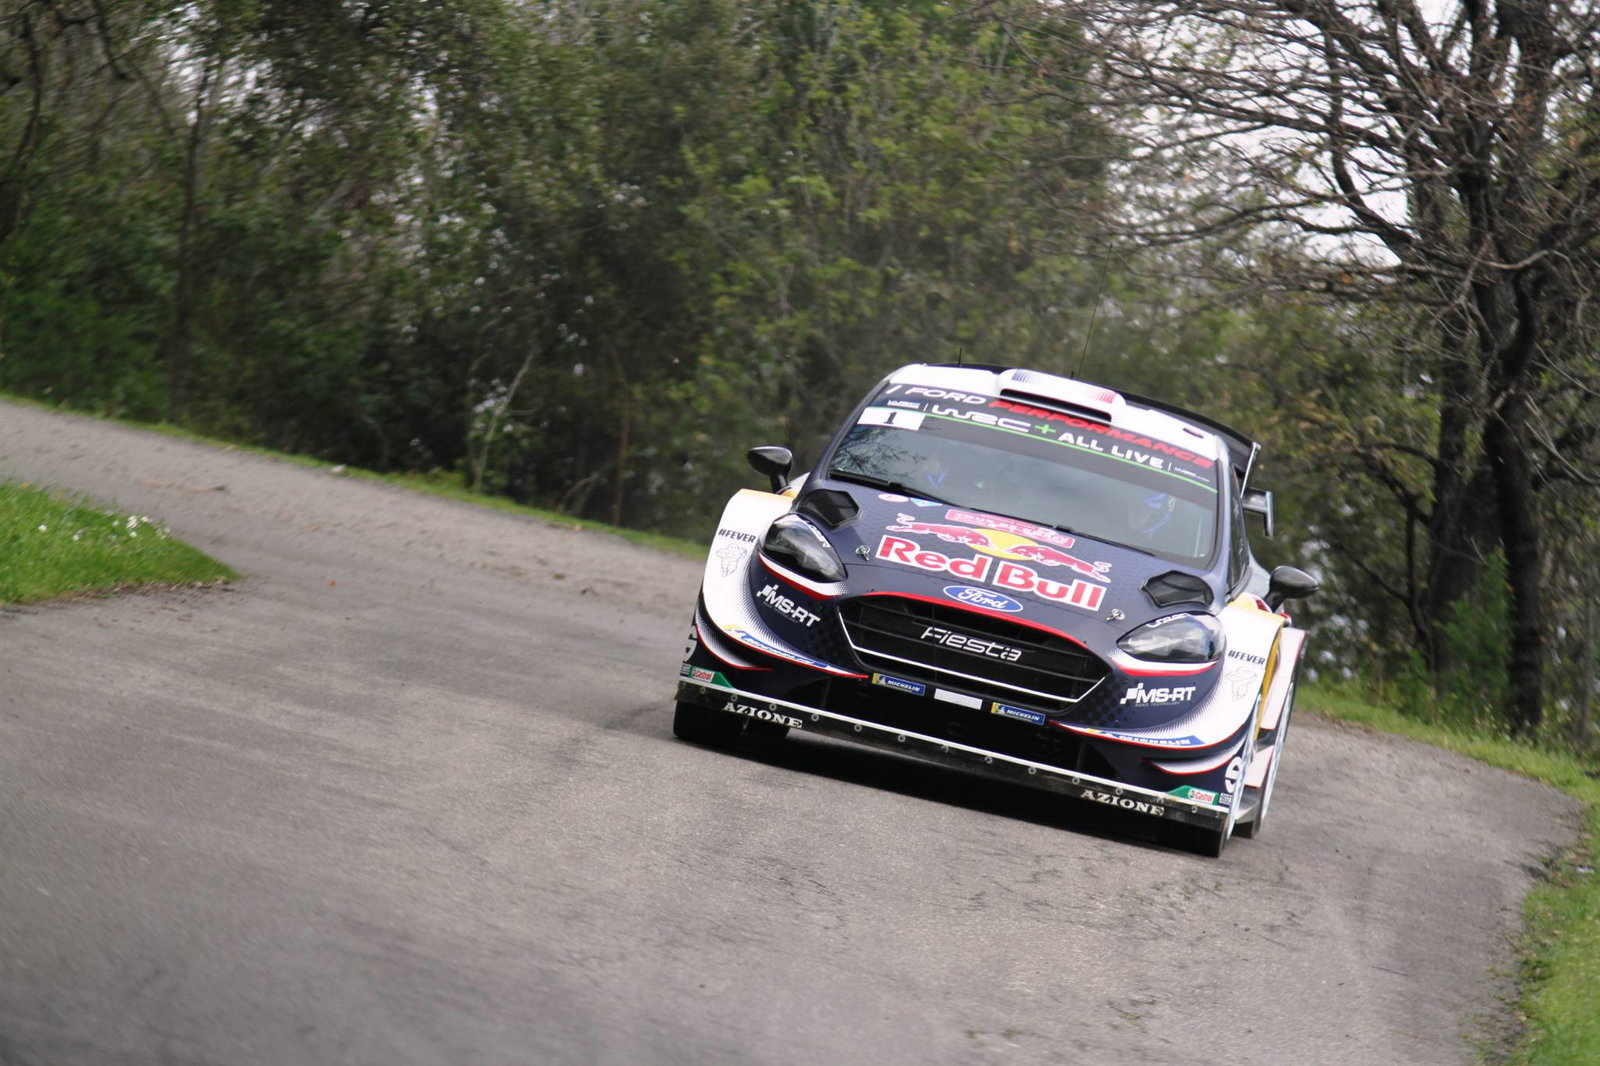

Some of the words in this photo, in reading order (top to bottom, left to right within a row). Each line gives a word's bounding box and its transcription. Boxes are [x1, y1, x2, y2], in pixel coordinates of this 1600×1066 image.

[883, 411, 898, 425] 1
[905, 387, 987, 405] FORD
[988, 399, 1214, 469] PERFORMANCE
[1058, 432, 1103, 451] ALL
[1111, 445, 1164, 469] LIVE
[718, 528, 756, 544] #FEVER
[876, 536, 993, 581] Red
[993, 561, 1107, 611] Bull
[957, 587, 1007, 609] Ford
[921, 626, 1022, 662] Fiesta
[1228, 650, 1266, 665] #FEVER
[887, 678, 921, 693] MICHELIN
[723, 702, 803, 729] AZIONE
[1006, 709, 1040, 722] MICHELIN
[1080, 789, 1165, 816] AZIONE
